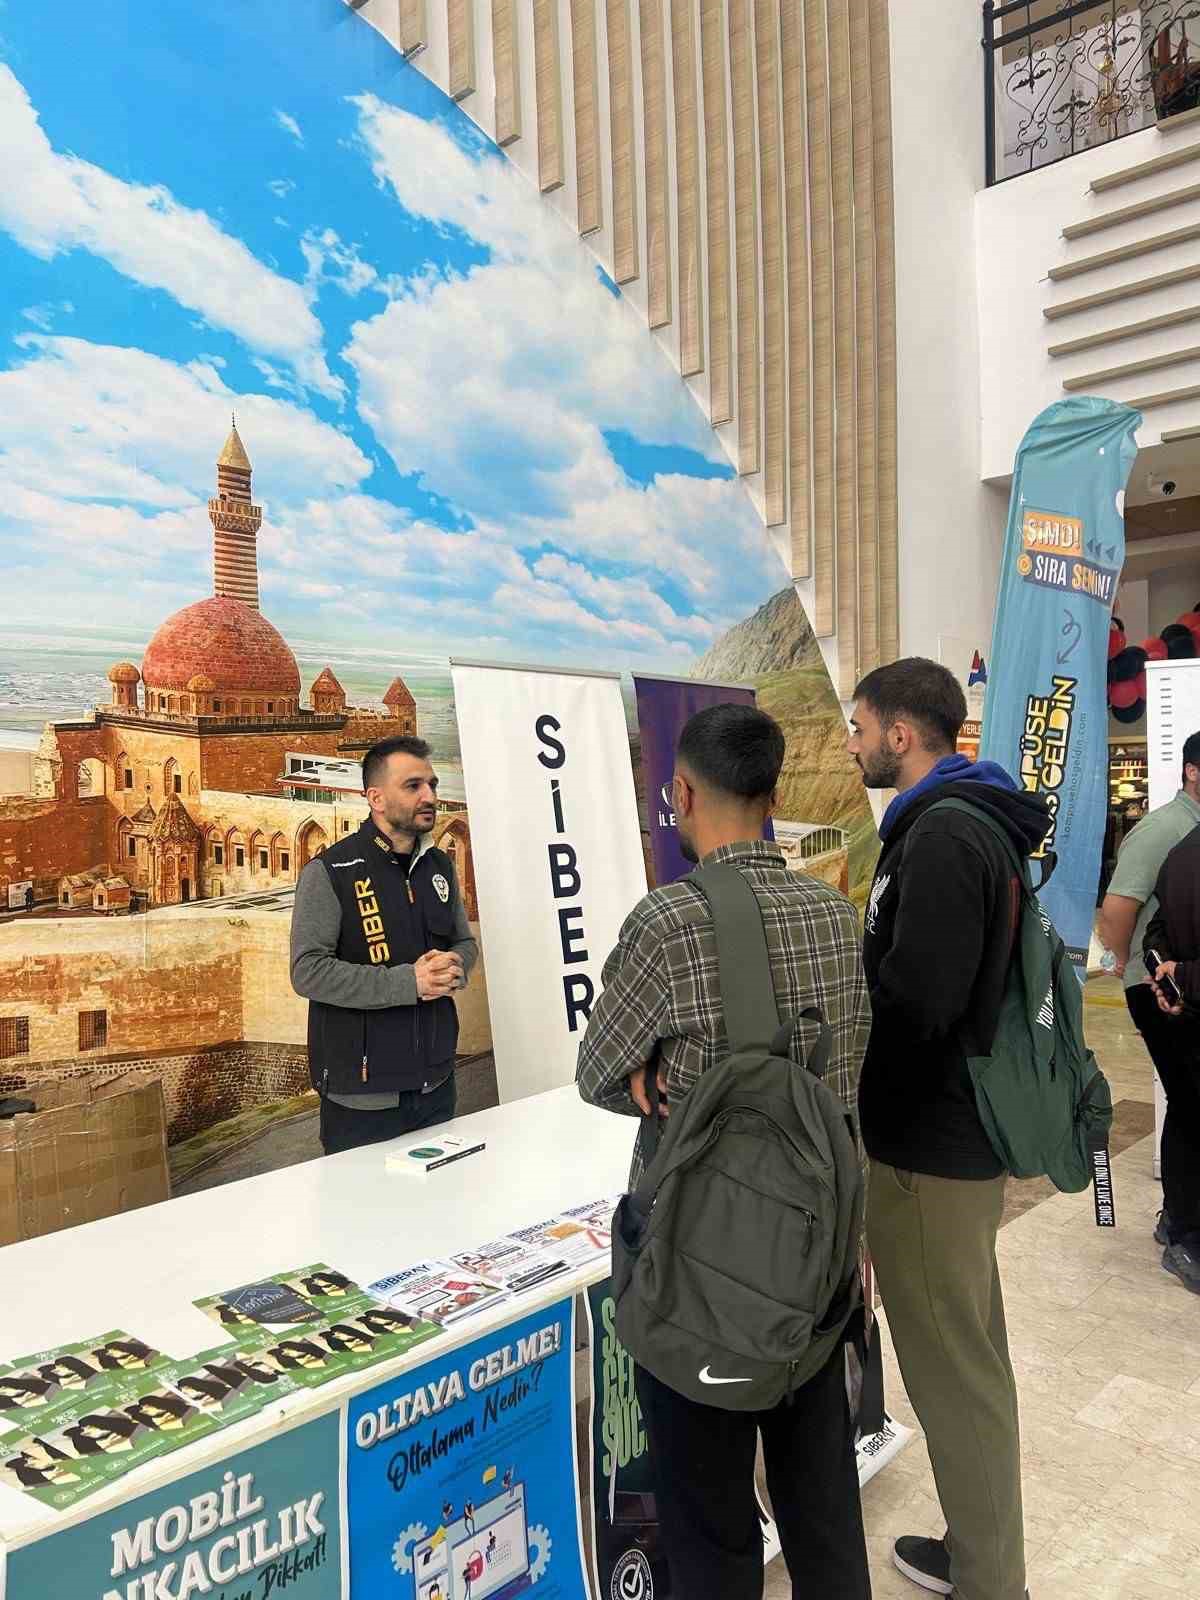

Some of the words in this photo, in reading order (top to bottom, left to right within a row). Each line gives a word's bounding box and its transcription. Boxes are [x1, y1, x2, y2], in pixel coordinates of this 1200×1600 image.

[1035, 556, 1067, 586] SIRA
[1021, 697, 1048, 792] MPÜSE
[1042, 677, 1077, 788] GELDİN
[535, 713, 596, 1035] SİBER
[1093, 1150, 1107, 1166] YOU
[1095, 1167, 1109, 1187] ONLY
[1096, 1187, 1111, 1205] LIVE
[1098, 1205, 1113, 1225] ONCE
[376, 1263, 431, 1290] SIBERAY
[355, 1370, 466, 1449] OLTAYA
[469, 1322, 562, 1392] GELME!
[482, 1361, 544, 1432] Nedir?
[863, 1424, 897, 1457] SIBERAY
[110, 1471, 265, 1578] MOBİL
[258, 1532, 327, 1599] Dikkat!
